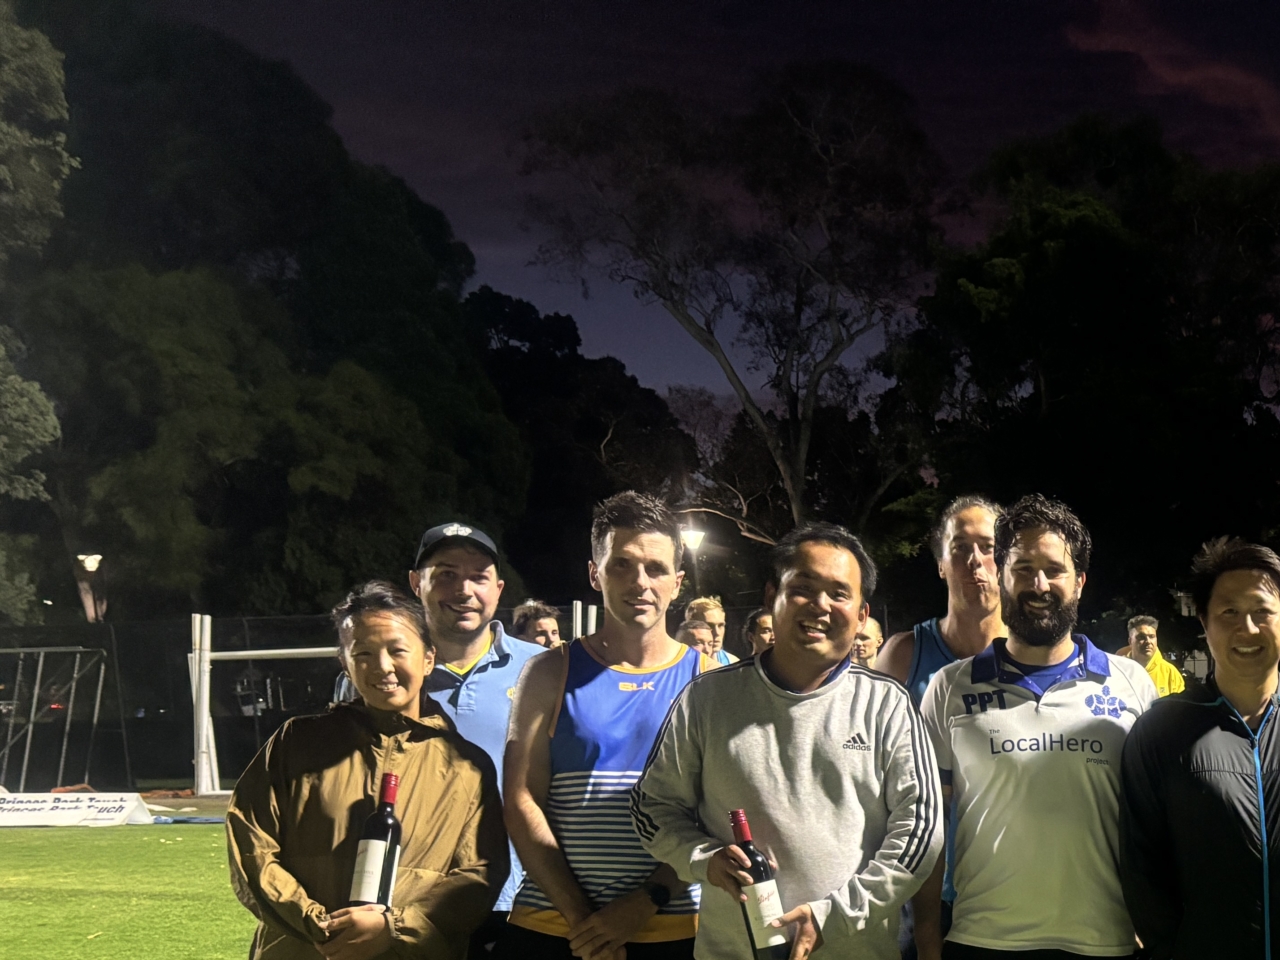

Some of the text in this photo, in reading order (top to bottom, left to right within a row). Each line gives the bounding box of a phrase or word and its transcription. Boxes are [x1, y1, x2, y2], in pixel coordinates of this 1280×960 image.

[618, 681, 655, 691] BLK
[962, 689, 1007, 715] PPT
[842, 743, 872, 752] adidas
[989, 732, 1104, 755] LocalHero
[1086, 757, 1109, 766] project
